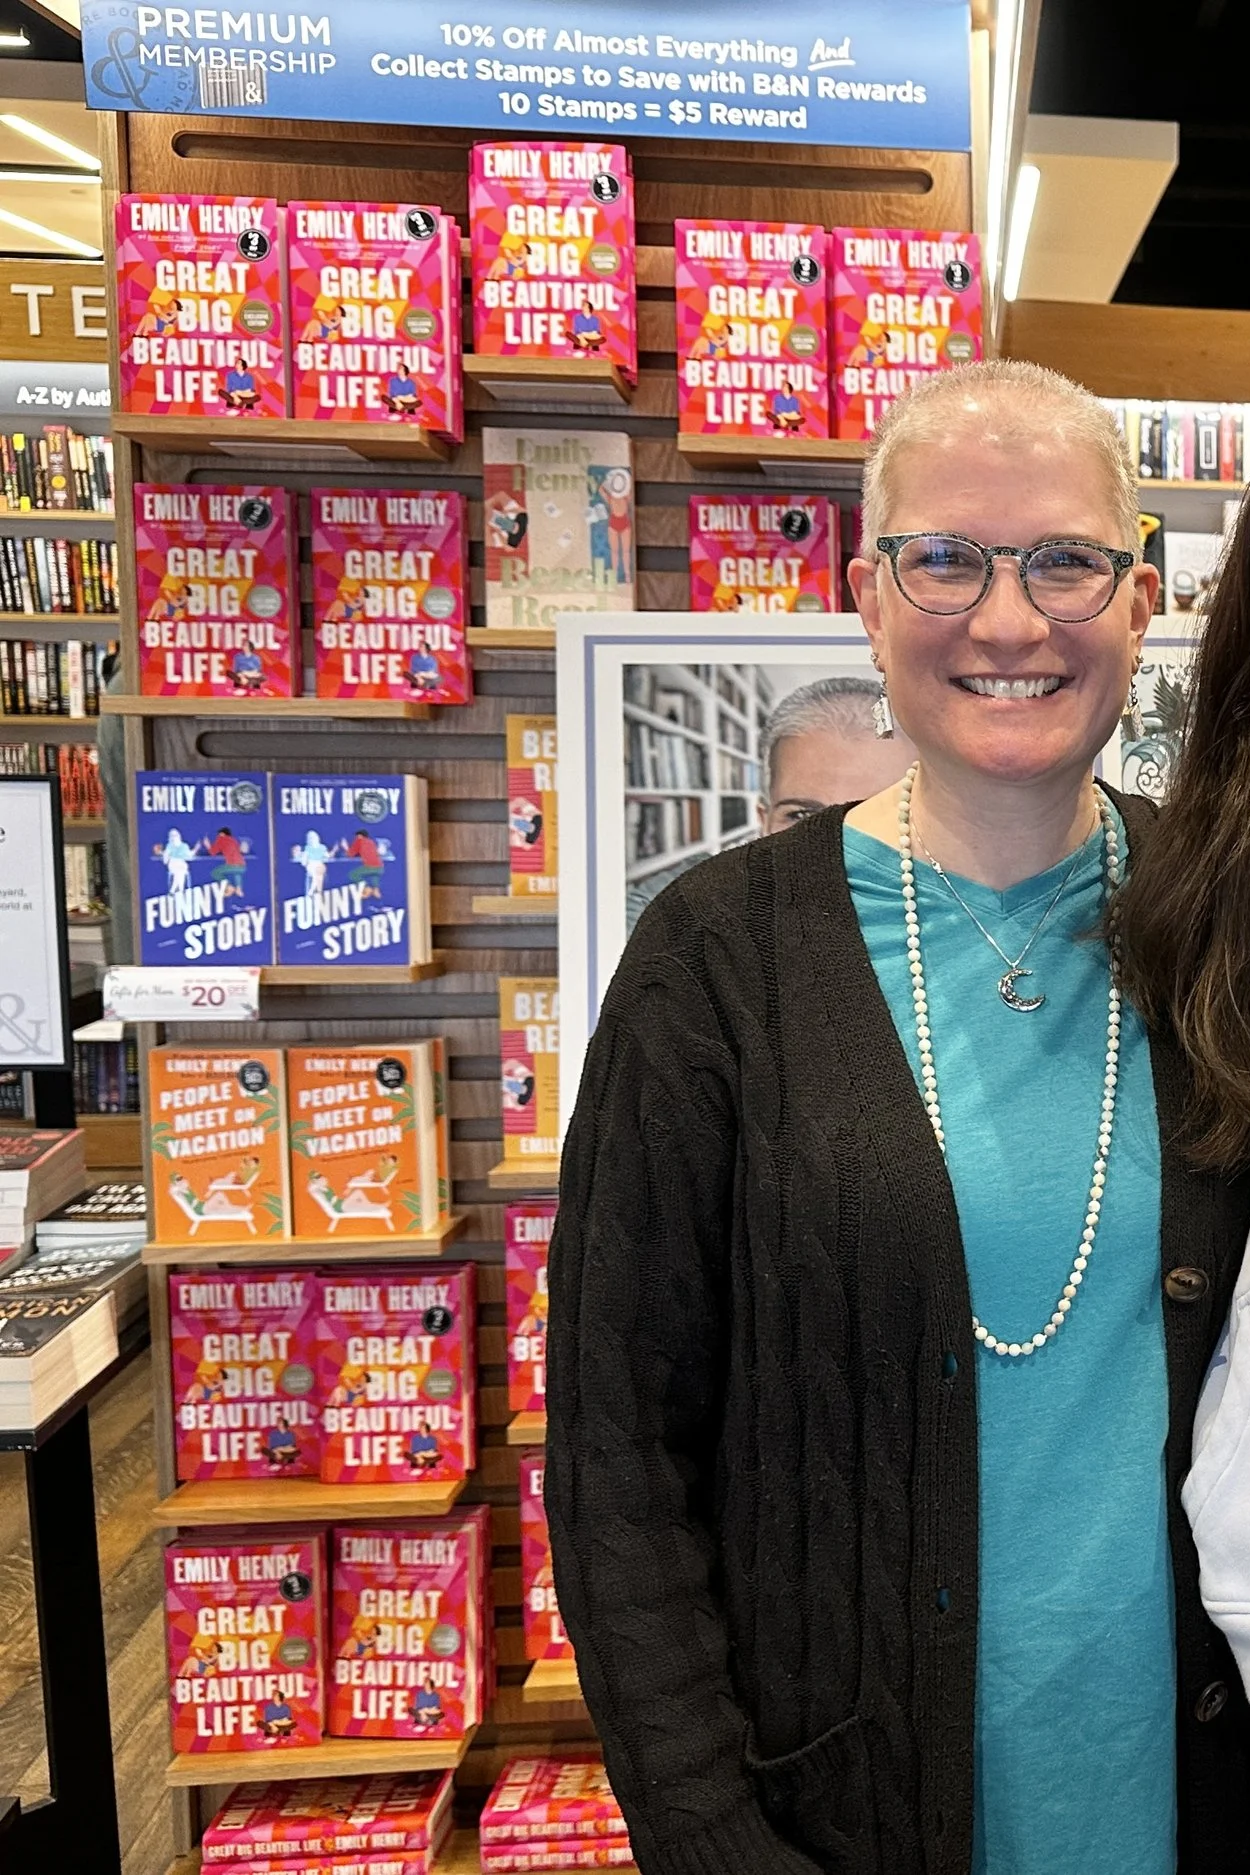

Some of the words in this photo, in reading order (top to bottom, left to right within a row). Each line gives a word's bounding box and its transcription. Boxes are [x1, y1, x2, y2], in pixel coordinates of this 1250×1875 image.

[138, 6, 331, 46] PREMIUM
[140, 44, 336, 75] MEMBERSHIP
[440, 23, 496, 48] 10%
[502, 26, 547, 51] Off
[553, 29, 649, 56] Almost
[656, 34, 798, 68] Everything
[808, 36, 854, 66] And
[371, 53, 469, 80] Collect
[475, 58, 576, 88] Stamps
[582, 64, 612, 87] to
[618, 65, 682, 92] Save
[688, 70, 746, 95] with
[753, 73, 809, 98] B&N
[817, 76, 927, 104] Rewards
[498, 92, 531, 115] 10
[538, 94, 638, 123] Stamps
[668, 99, 701, 126] $5
[709, 102, 808, 129] Reward
[483, 149, 541, 178] EMILY
[550, 150, 612, 180] HENRY
[131, 203, 189, 232] EMILY
[200, 205, 264, 234] HENRY
[297, 210, 354, 239] EMILY
[364, 212, 411, 242] HEN
[507, 205, 598, 237] GREAT
[526, 242, 580, 276] BIG
[686, 229, 743, 258] EMILY
[751, 232, 812, 261] HENRY
[844, 238, 899, 266] EMILY
[908, 240, 968, 268] HENRY
[156, 259, 250, 293] GREAT
[320, 266, 413, 300] GREAT
[484, 281, 620, 311] BEAUTIFUL
[708, 285, 798, 319] GREAT
[867, 293, 953, 326] GREAT
[178, 298, 233, 333] BIG
[341, 304, 395, 339] BIG
[505, 312, 566, 345] LIFE
[132, 337, 274, 368] BEAUTIFUL
[728, 323, 780, 357] BIG
[886, 330, 937, 364] BIG
[298, 344, 435, 374] BEAUTIFUL
[156, 370, 220, 403] LIFE
[685, 360, 818, 392] BEAUTIFUL
[16, 385, 49, 404] A-Z
[51, 387, 73, 408] by
[320, 376, 381, 408] LIFE
[706, 391, 767, 425] LIFE
[516, 437, 594, 464] Emily
[144, 494, 199, 521] EMILY
[321, 496, 378, 523] EMILY
[386, 498, 448, 525] HENRY
[698, 504, 750, 531] EMILY
[167, 547, 258, 578] GREAT
[345, 550, 434, 581] GREAT
[500, 556, 619, 593] Beach
[720, 557, 803, 587] GREAT
[188, 583, 240, 617] BIG
[365, 585, 417, 619] BIG
[741, 592, 787, 612] BIG
[145, 621, 281, 650] BEAUTIFUL
[321, 623, 457, 651] BEAUTIFUL
[166, 652, 227, 684] LIFE
[343, 653, 404, 685] LIFE
[142, 785, 195, 812] EMILY
[281, 787, 333, 814] EMILY
[145, 880, 228, 933] FUNNY
[284, 881, 366, 934] FUNNY
[184, 908, 267, 960] STORY
[322, 909, 405, 960] STORY
[182, 986, 226, 1007] $20
[166, 1059, 208, 1073] EMILY
[160, 1081, 232, 1110] PEOPLE
[299, 1080, 370, 1109] PEOPLE
[174, 1106, 229, 1133] MEET
[234, 1108, 256, 1123] ON
[167, 1125, 265, 1159] VACATION
[179, 1284, 234, 1310] EMILY
[243, 1282, 304, 1309] HENRY
[324, 1286, 380, 1312] EMILY
[388, 1285, 449, 1311] HENRY
[203, 1332, 291, 1362] GREAT
[347, 1336, 435, 1366] GREAT
[223, 1366, 275, 1398] BIG
[367, 1370, 418, 1402] BIG
[181, 1401, 314, 1430] BEAUTIFUL
[324, 1405, 456, 1433] BEAUTIFUL
[202, 1431, 262, 1462] LIFE
[344, 1436, 404, 1466] LIFE
[173, 1556, 230, 1584] EMILY
[238, 1554, 300, 1581] HENRY
[198, 1605, 287, 1636] GREAT
[218, 1640, 271, 1672] BIG
[175, 1674, 310, 1704] BEAUTIFUL
[196, 1705, 258, 1737] LIFE
[207, 1844, 235, 1858] GREAT
[255, 1840, 301, 1855] BEAUTIFUL
[336, 1834, 368, 1849] EMILY
[372, 1831, 407, 1847] HENRY
